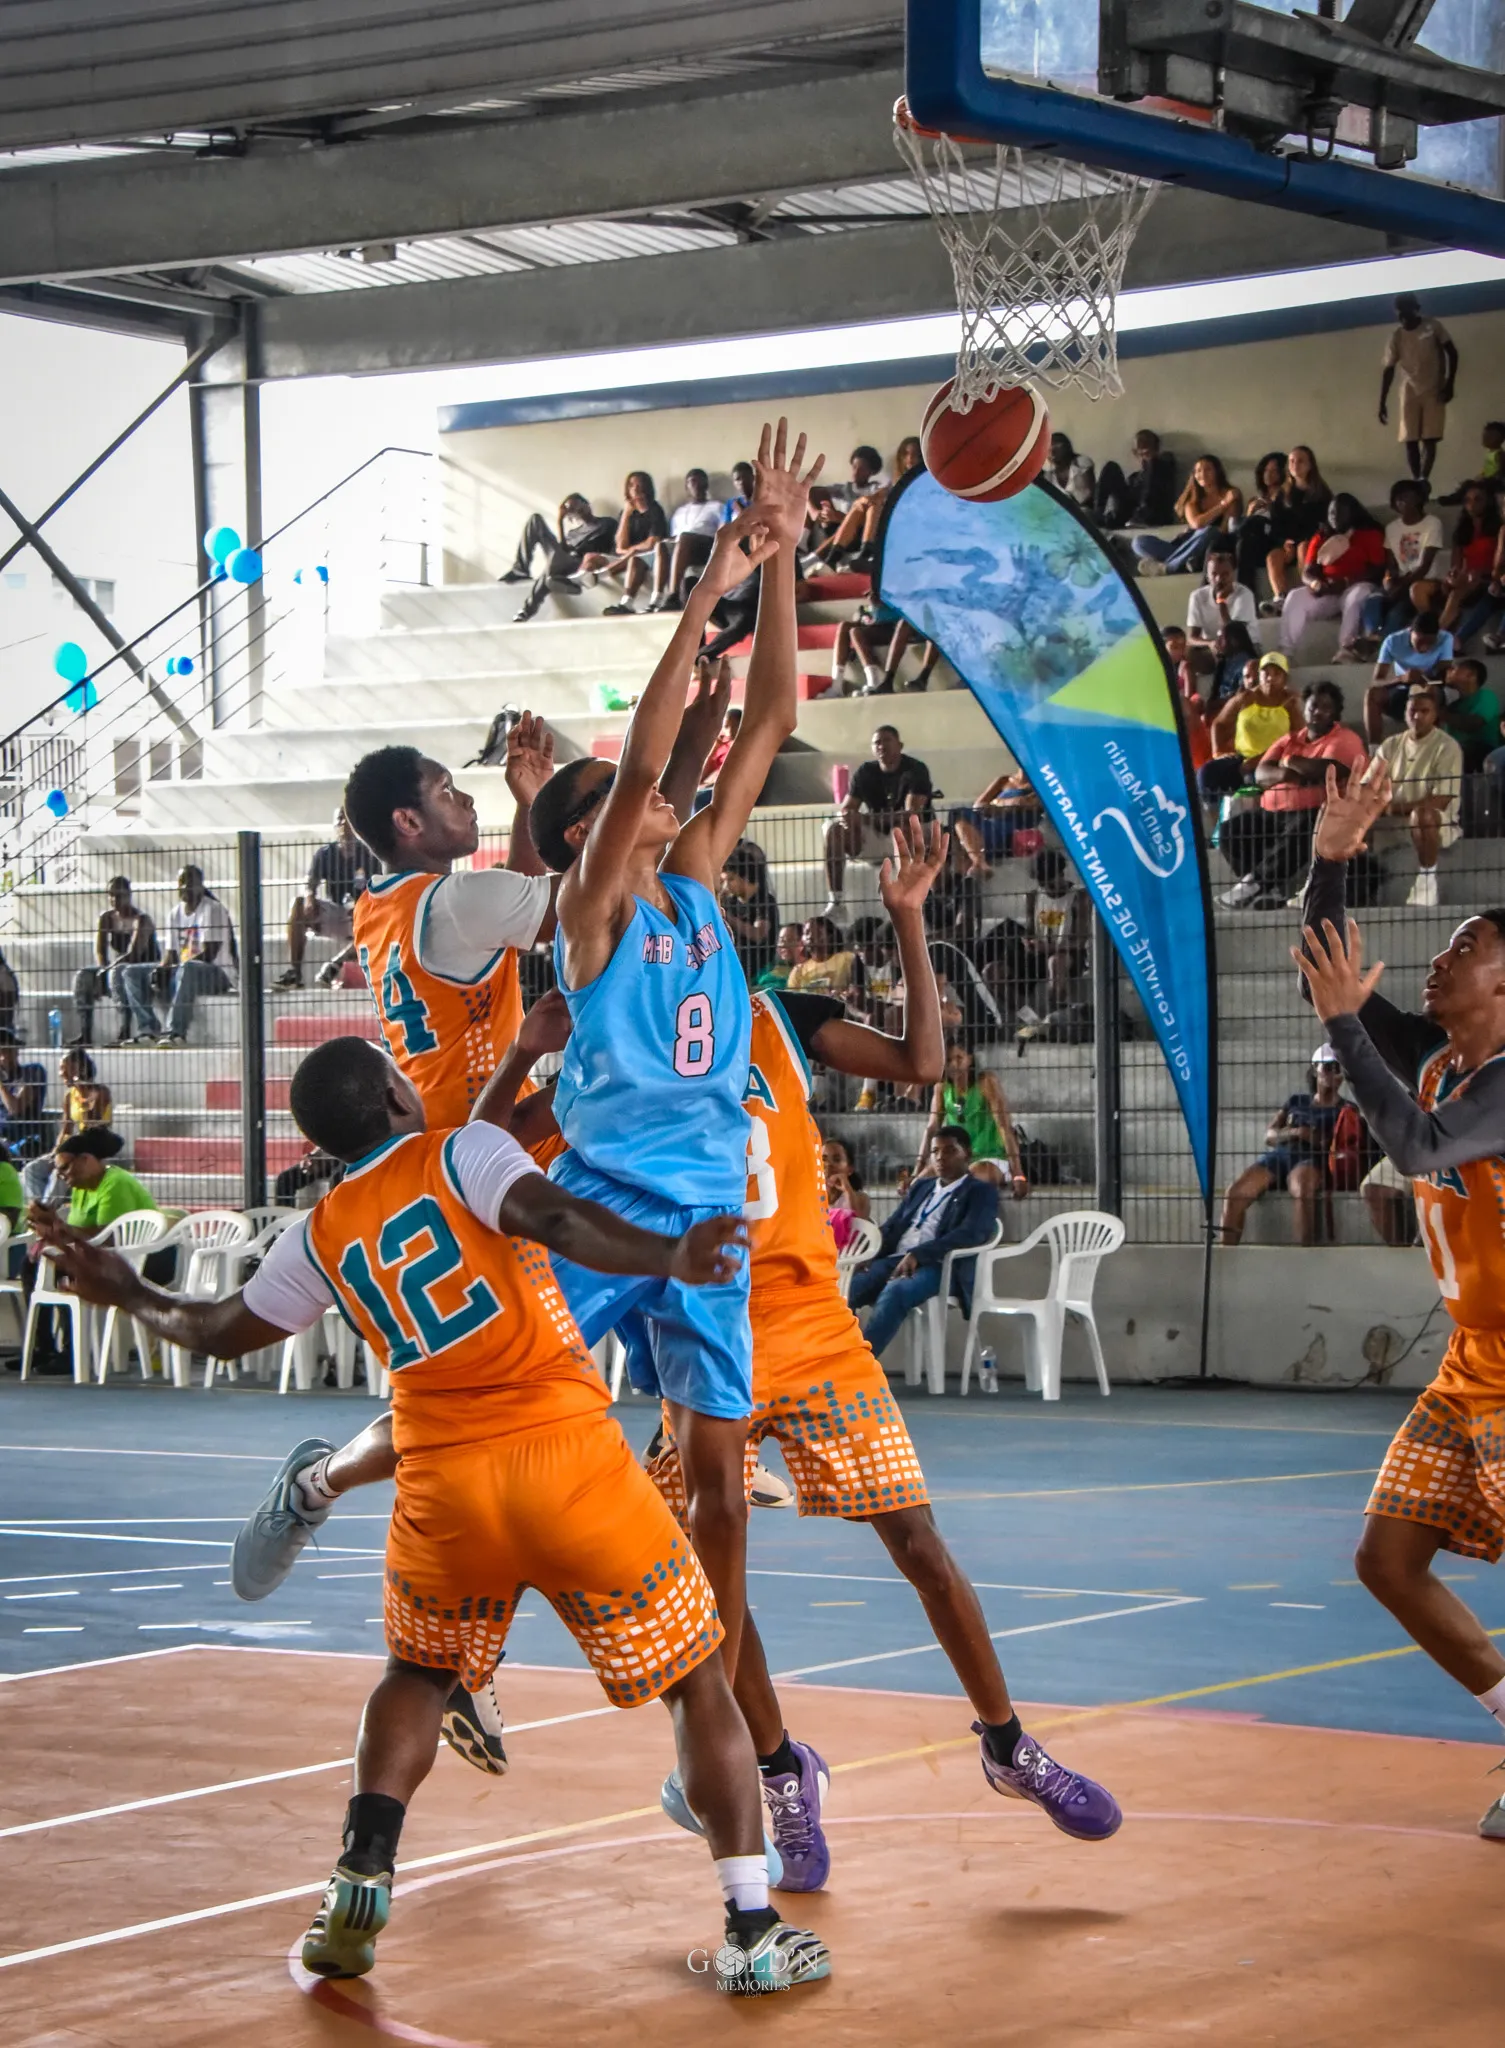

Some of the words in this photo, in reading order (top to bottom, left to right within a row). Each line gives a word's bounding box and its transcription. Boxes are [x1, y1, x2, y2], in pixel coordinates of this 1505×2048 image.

[358, 940, 440, 1058] 14
[642, 934, 675, 965] MHB
[673, 991, 716, 1078] 8
[337, 1193, 505, 1373] 12
